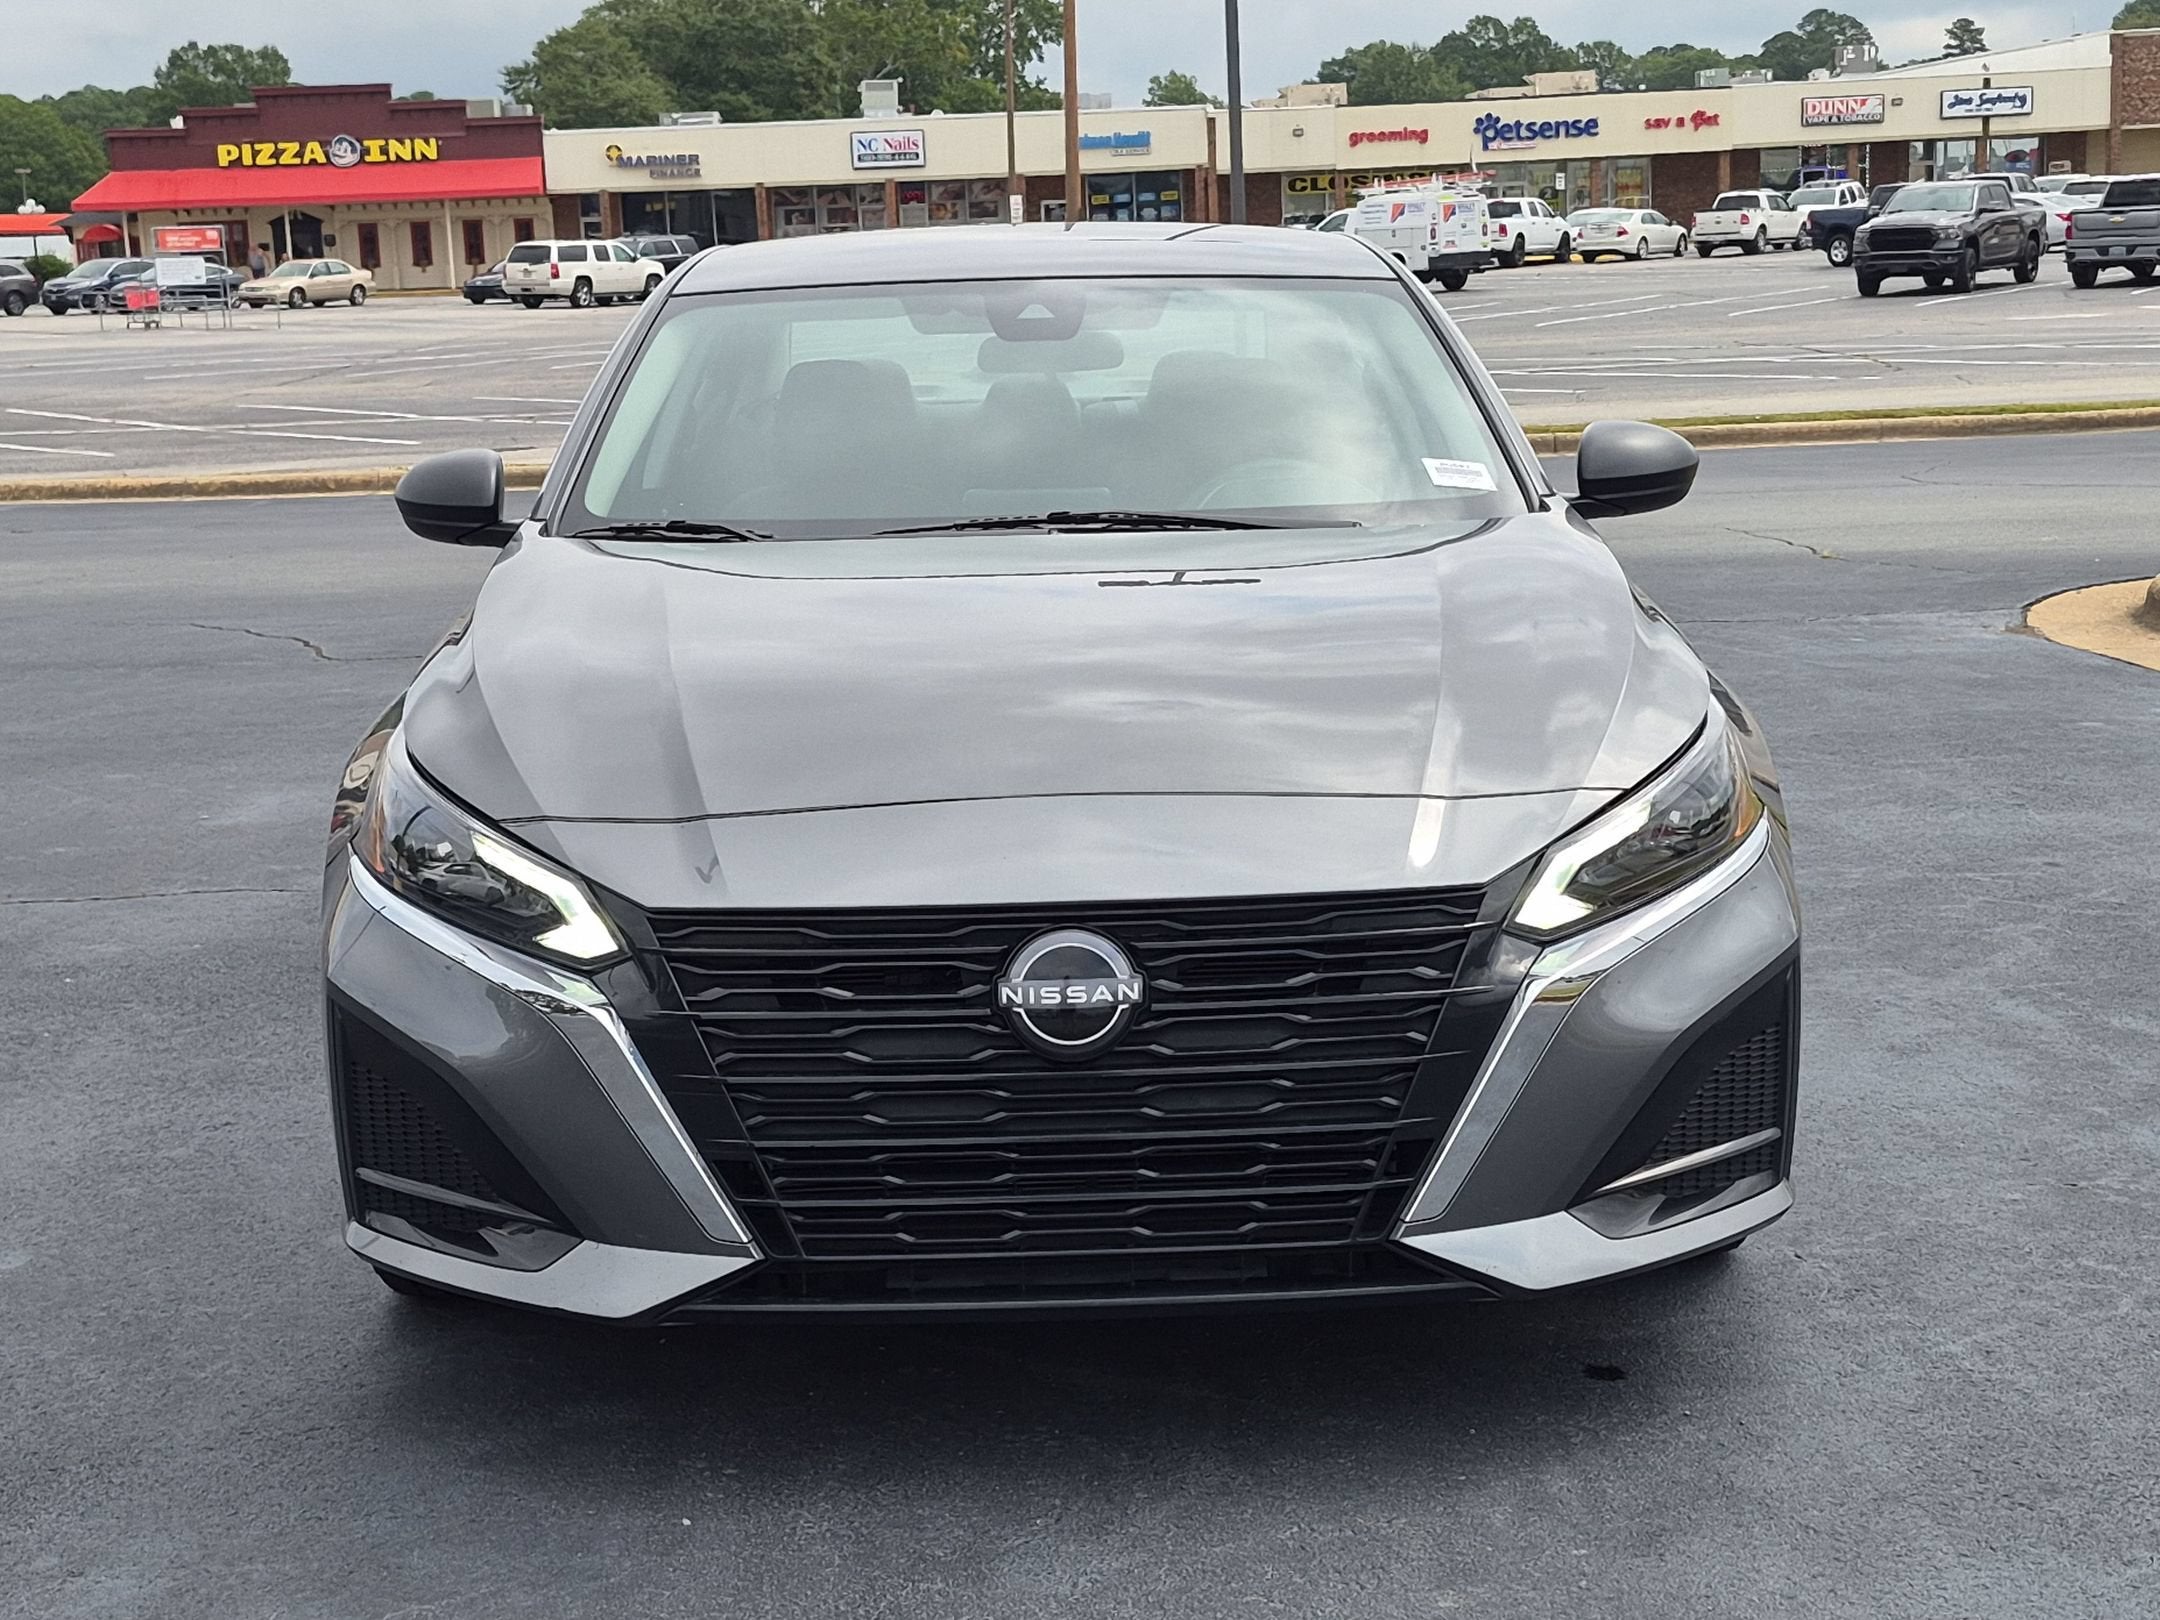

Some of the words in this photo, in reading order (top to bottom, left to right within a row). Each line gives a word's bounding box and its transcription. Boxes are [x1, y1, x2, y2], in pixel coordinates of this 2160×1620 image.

[1806, 98, 1861, 116] DUNN
[1349, 127, 1429, 148] grooming
[1473, 113, 1600, 152] petsense
[216, 141, 327, 167] PIZZA
[362, 137, 439, 163] INN
[857, 138, 879, 152] NC
[883, 136, 919, 151] Nails
[616, 154, 700, 169] MARINER
[1001, 982, 1140, 1005] NISSAN
